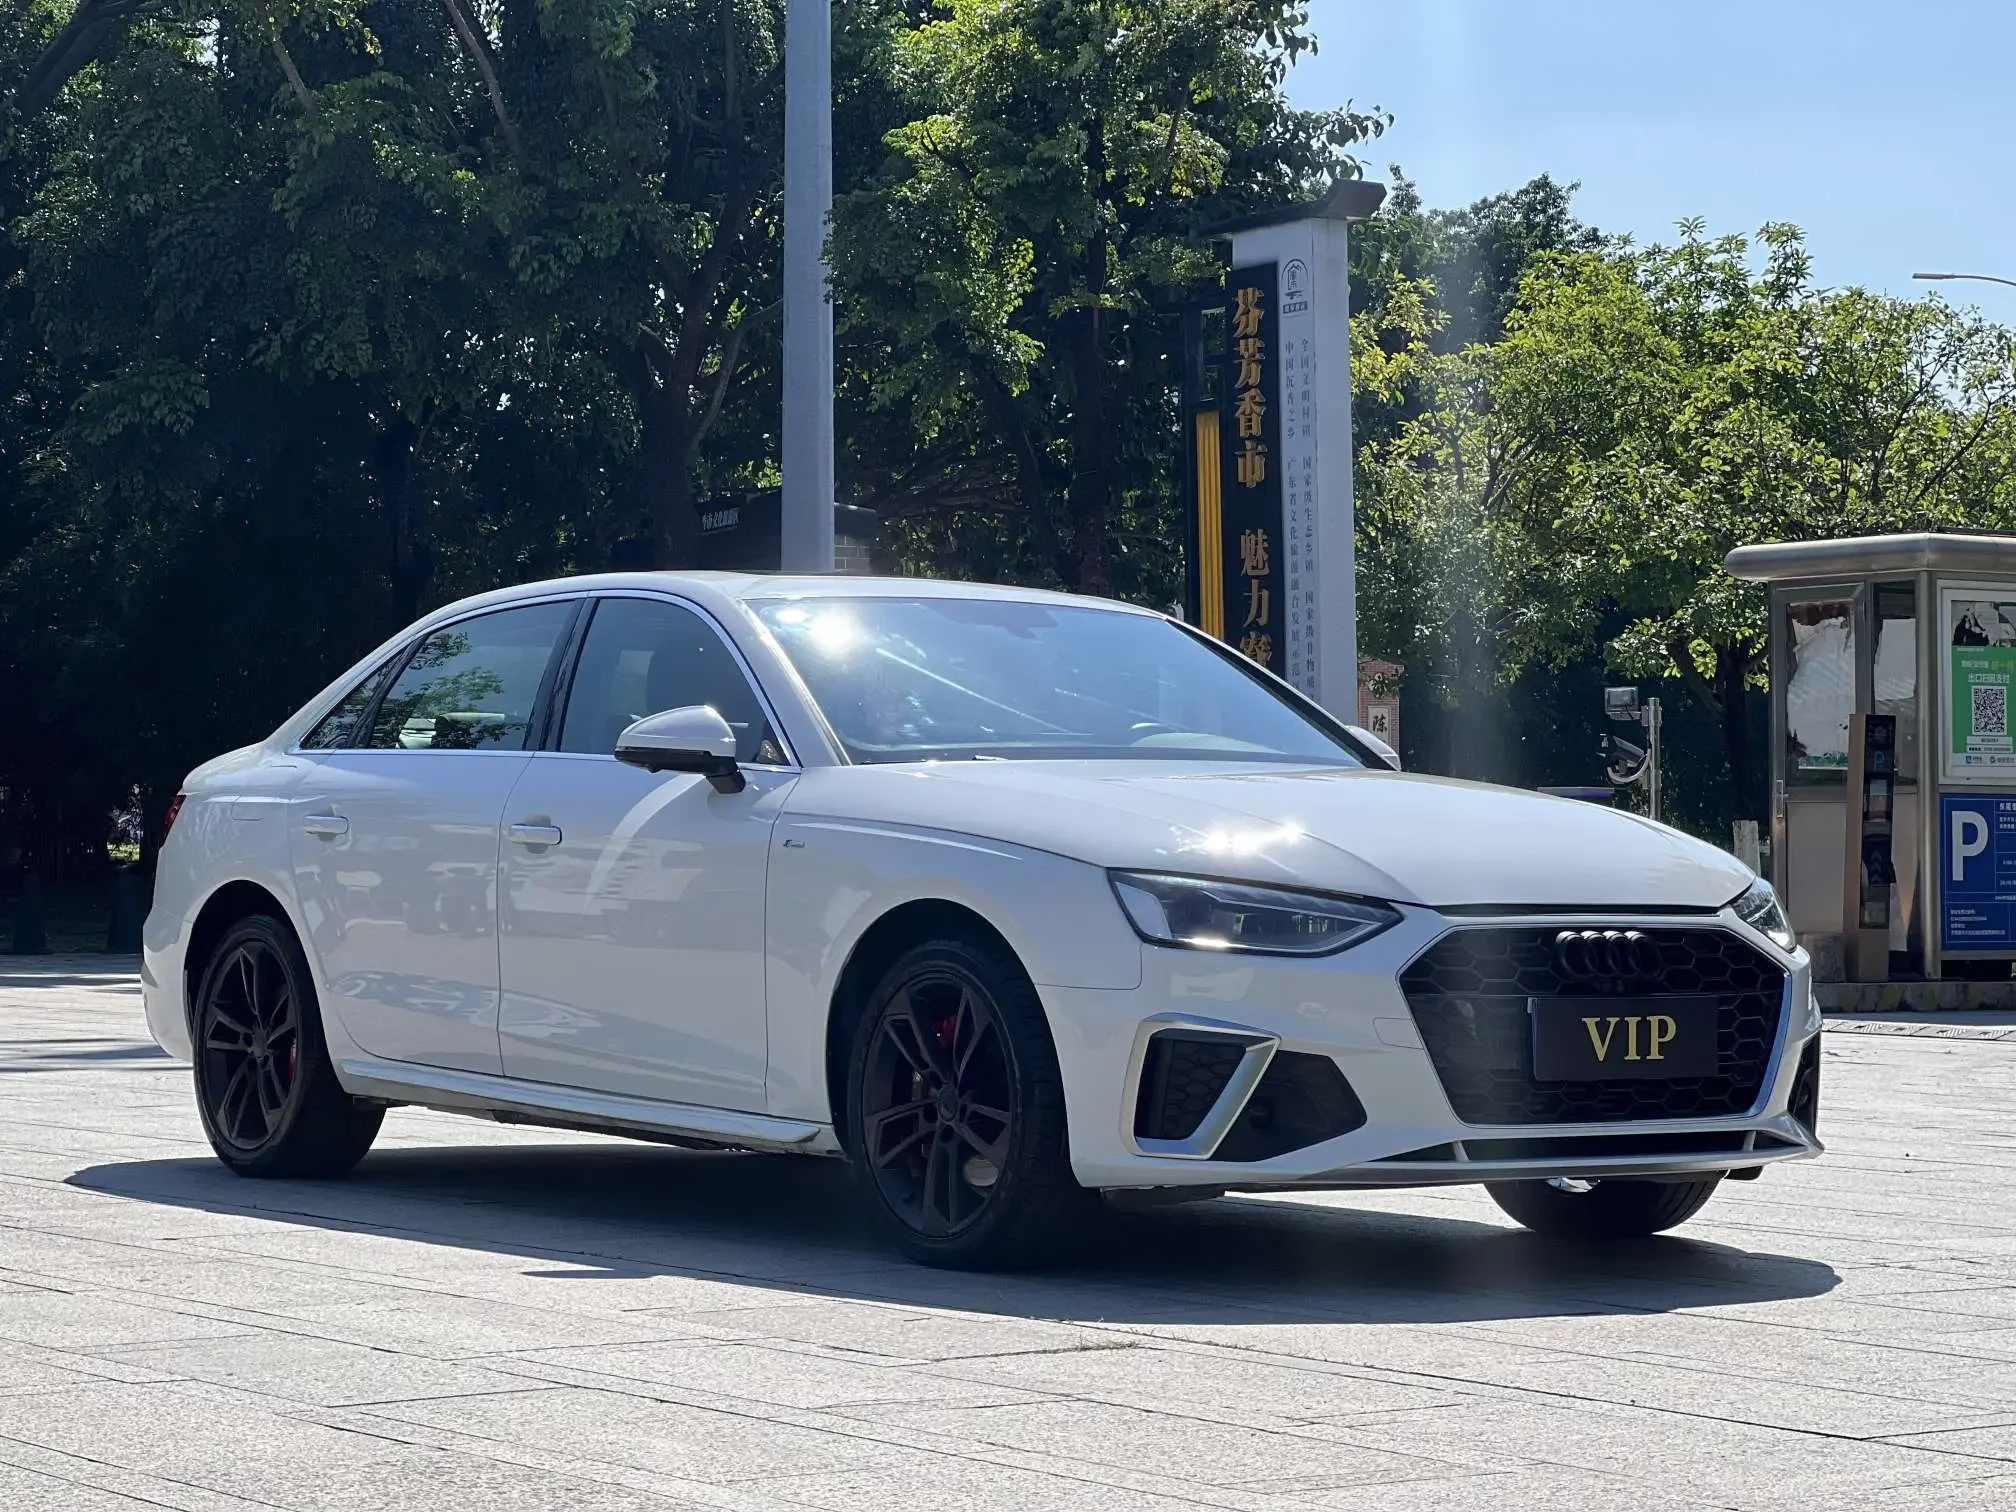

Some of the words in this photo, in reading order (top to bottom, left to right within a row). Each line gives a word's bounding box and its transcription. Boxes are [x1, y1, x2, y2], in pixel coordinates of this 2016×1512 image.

[1232, 287, 1268, 488] 芬芳香市
[1372, 712, 1388, 733] 陈
[1951, 810, 1989, 882] P
[1581, 1015, 1677, 1062] VIP
